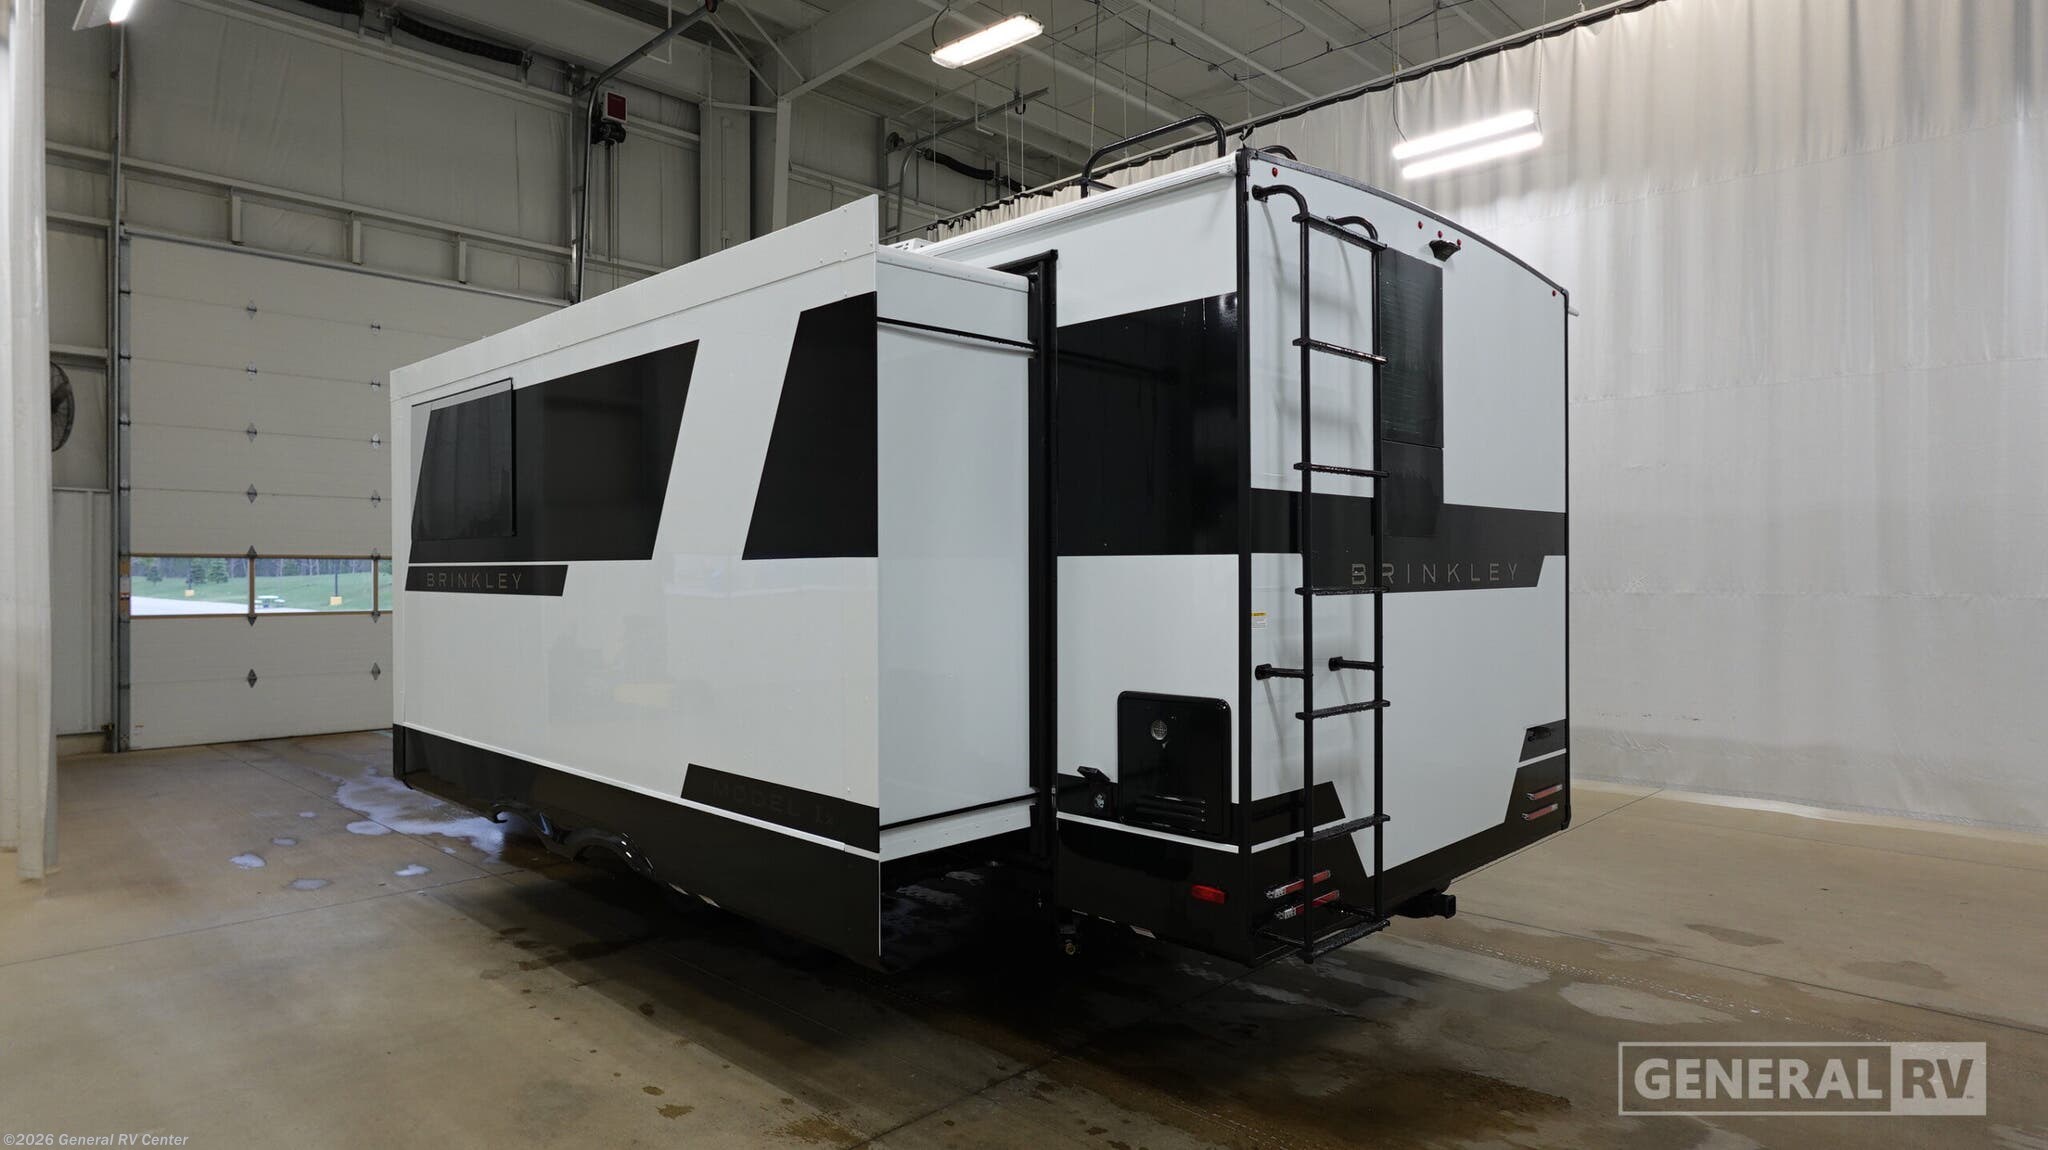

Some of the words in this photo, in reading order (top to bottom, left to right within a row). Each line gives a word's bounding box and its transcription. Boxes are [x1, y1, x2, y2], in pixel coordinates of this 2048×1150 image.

[426, 572, 522, 590] BRINKLEY
[1351, 562, 1518, 585] BRINKLEY
[712, 777, 801, 817] MODEL
